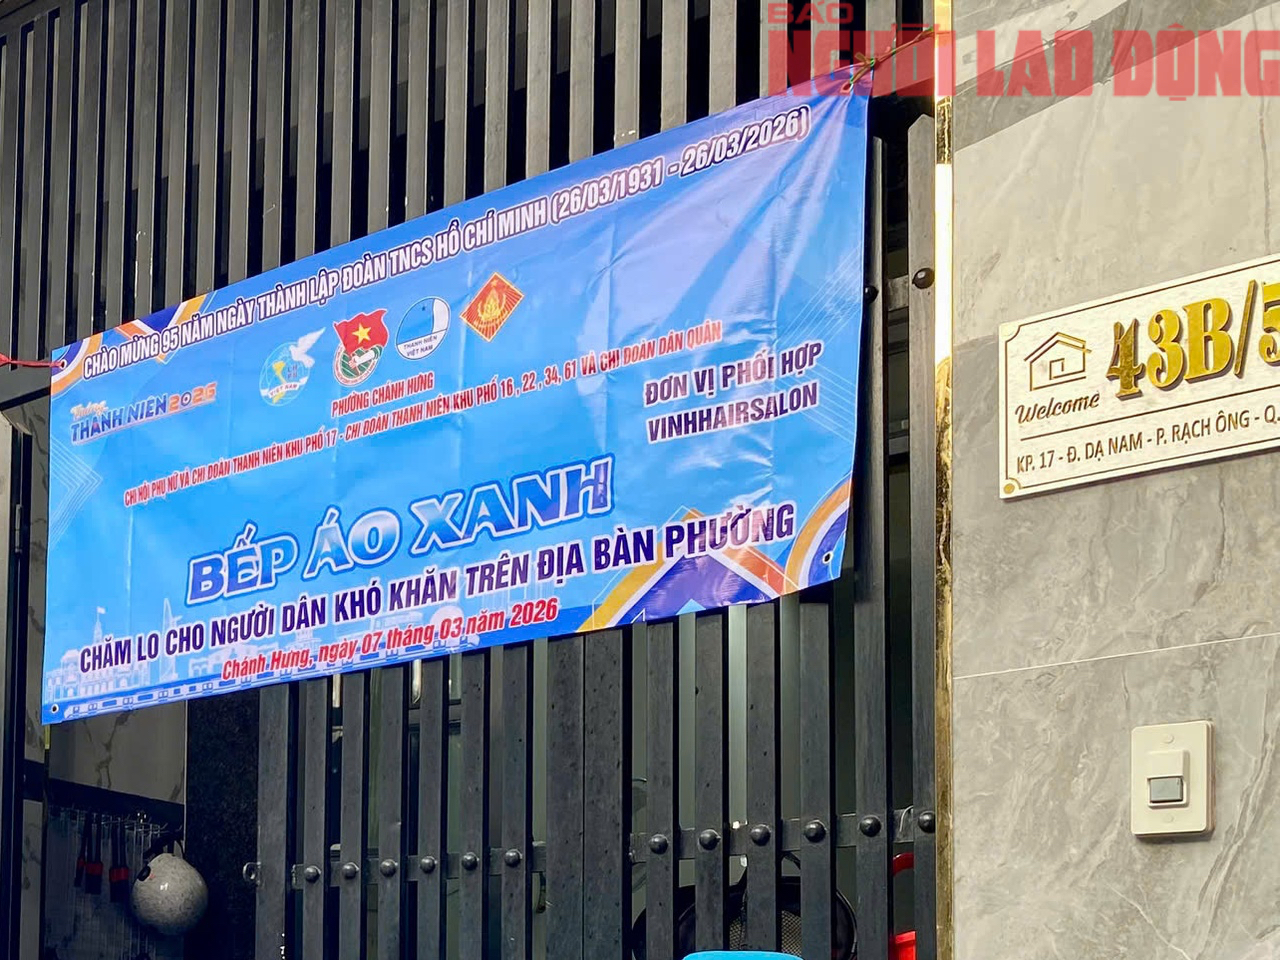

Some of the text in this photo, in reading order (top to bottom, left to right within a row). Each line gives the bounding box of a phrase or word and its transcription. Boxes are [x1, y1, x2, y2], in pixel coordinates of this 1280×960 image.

[83, 344, 118, 379] CHÀO
[120, 332, 161, 368] MỪNG
[162, 325, 179, 351] 95
[181, 314, 214, 346] NĂM
[216, 297, 255, 334] NGÀY
[258, 284, 307, 321] THÀNH
[308, 269, 340, 305] LẬP
[341, 253, 387, 293] ĐOÀN
[389, 237, 433, 275] TNCS
[435, 220, 460, 260] HỒ
[462, 209, 494, 252] CHÍ
[496, 196, 549, 242] MINH
[550, 157, 665, 226] (26/03/1931
[680, 105, 810, 178] 26/03/2026)
[332, 371, 434, 417] PHƯỜNG CHÁNH HƯNG
[645, 342, 822, 405] ĐƠN VỊ PHỐI HỢP
[71, 382, 217, 442] THANH NIÊN 2026
[124, 489, 137, 506] CHI
[180, 468, 190, 488] VÀ
[192, 467, 205, 486] CHI
[233, 450, 260, 474] THANH
[262, 441, 283, 465] NIÊN
[285, 438, 303, 459] KHU
[305, 426, 325, 453] PHỐ
[326, 429, 337, 447] 17
[345, 422, 361, 441] CHI
[363, 412, 389, 436] ĐOÀN
[391, 403, 423, 427] THANH
[426, 395, 450, 418] NIÊN
[453, 388, 473, 411] KHU
[476, 375, 498, 404] PHỐ
[564, 361, 576, 380] 61
[581, 353, 597, 375] VÀ
[600, 350, 620, 371] CHI
[623, 339, 656, 365] ĐOÀN
[658, 330, 683, 354] DÂN
[687, 320, 721, 349] QUÂN
[648, 382, 818, 442] VINHHAIRSALON
[1015, 392, 1100, 424] Welcome
[1017, 455, 1035, 474] KP.
[1040, 450, 1055, 470] 17
[1067, 445, 1081, 463] Đ.
[1085, 440, 1105, 461] DẠ
[1108, 432, 1143, 456] NAM
[1156, 428, 1168, 446] P.
[1172, 417, 1211, 445] RẠCH
[1216, 410, 1250, 433] ÔNG
[188, 455, 612, 604] BẾP ÁO XANH
[80, 504, 794, 674] CHĂM LO CHO NGƯỜI DÂN KHÓ KHĂN TRÊN ĐỊA BÀN PHƯỜNG
[222, 597, 558, 680] Chánh Hưng, ngày 07 tháng 03 năm 2026
